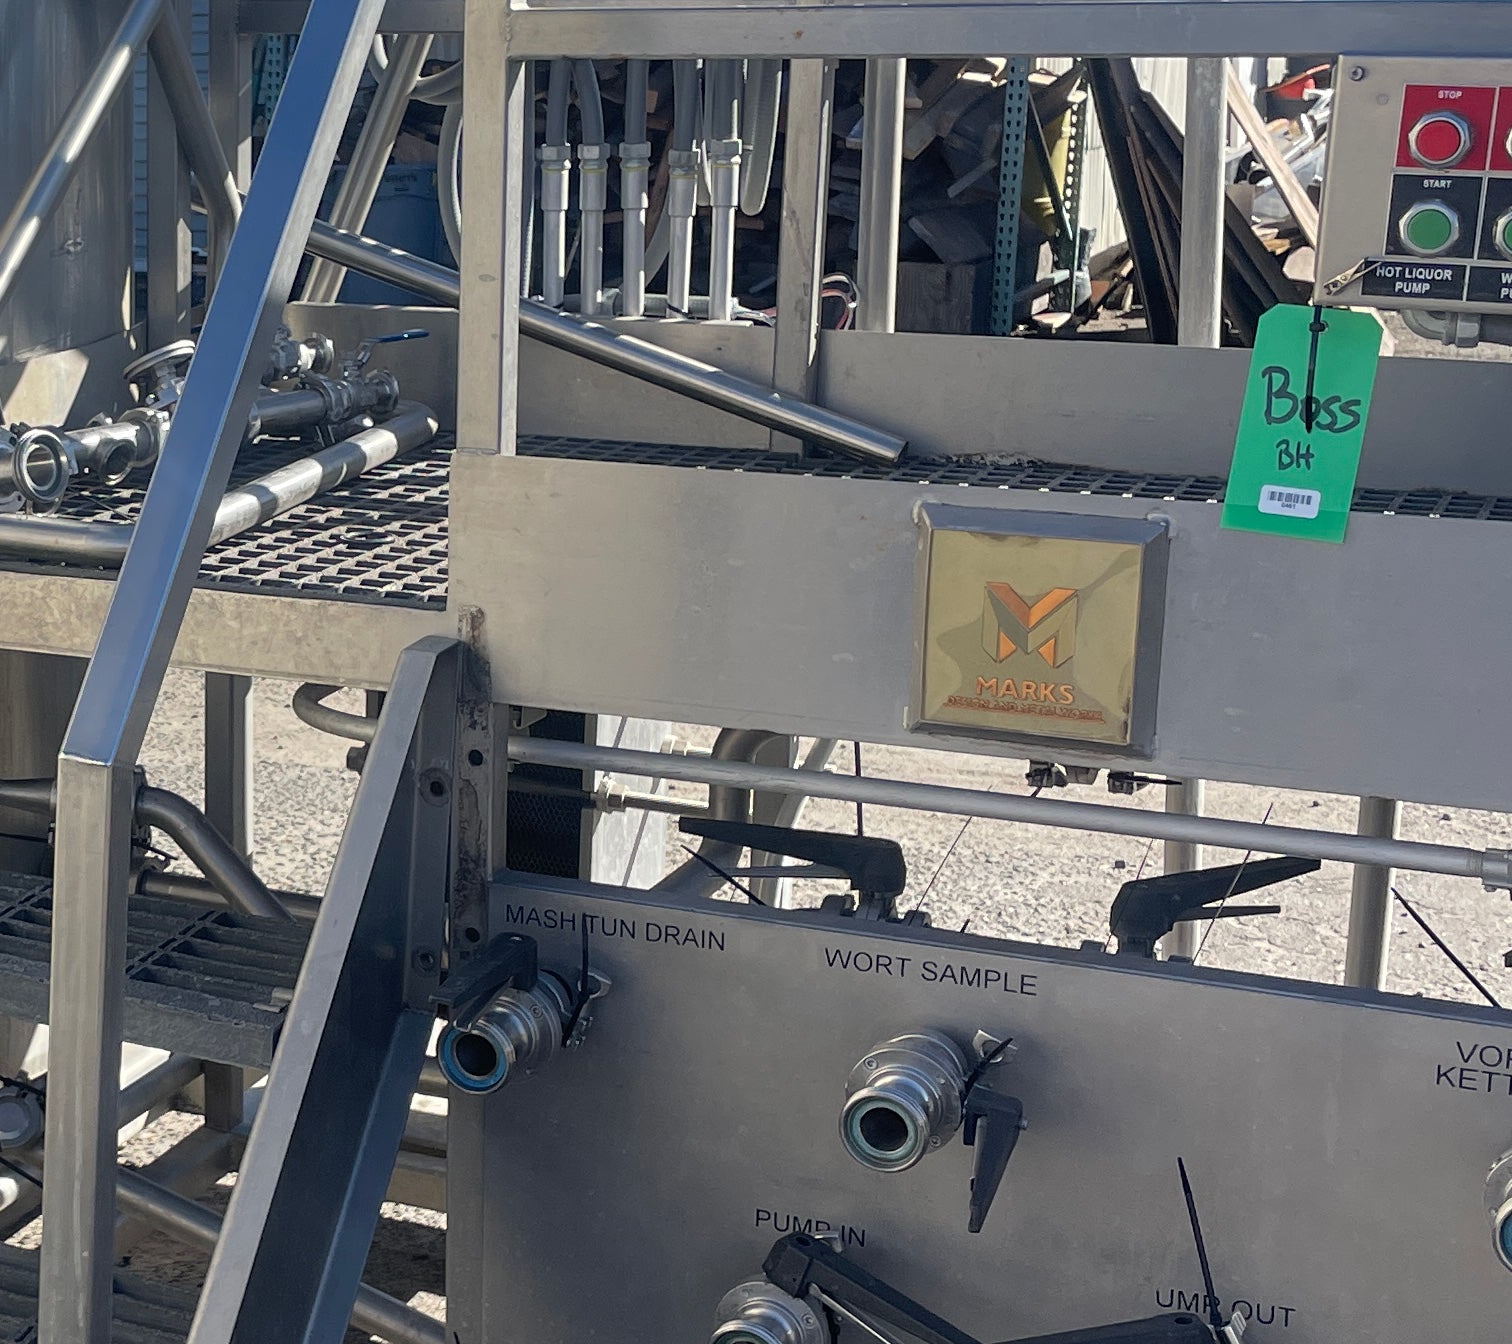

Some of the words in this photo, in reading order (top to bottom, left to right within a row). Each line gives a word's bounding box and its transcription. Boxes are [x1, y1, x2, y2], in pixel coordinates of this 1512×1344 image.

[1437, 90, 1463, 100] STOP
[1423, 179, 1452, 189] START
[1376, 267, 1401, 279] HOT
[1405, 268, 1453, 281] LIQUOR
[1394, 282, 1431, 294] PUMP
[976, 676, 1075, 704] MARKS
[506, 904, 576, 931] MASH
[585, 915, 636, 939] TUN
[646, 922, 725, 951] DRAIN
[825, 947, 911, 977] WORT
[921, 961, 1037, 996] SAMPLE
[841, 1225, 866, 1247] IN
[1232, 1300, 1296, 1327] OUT
